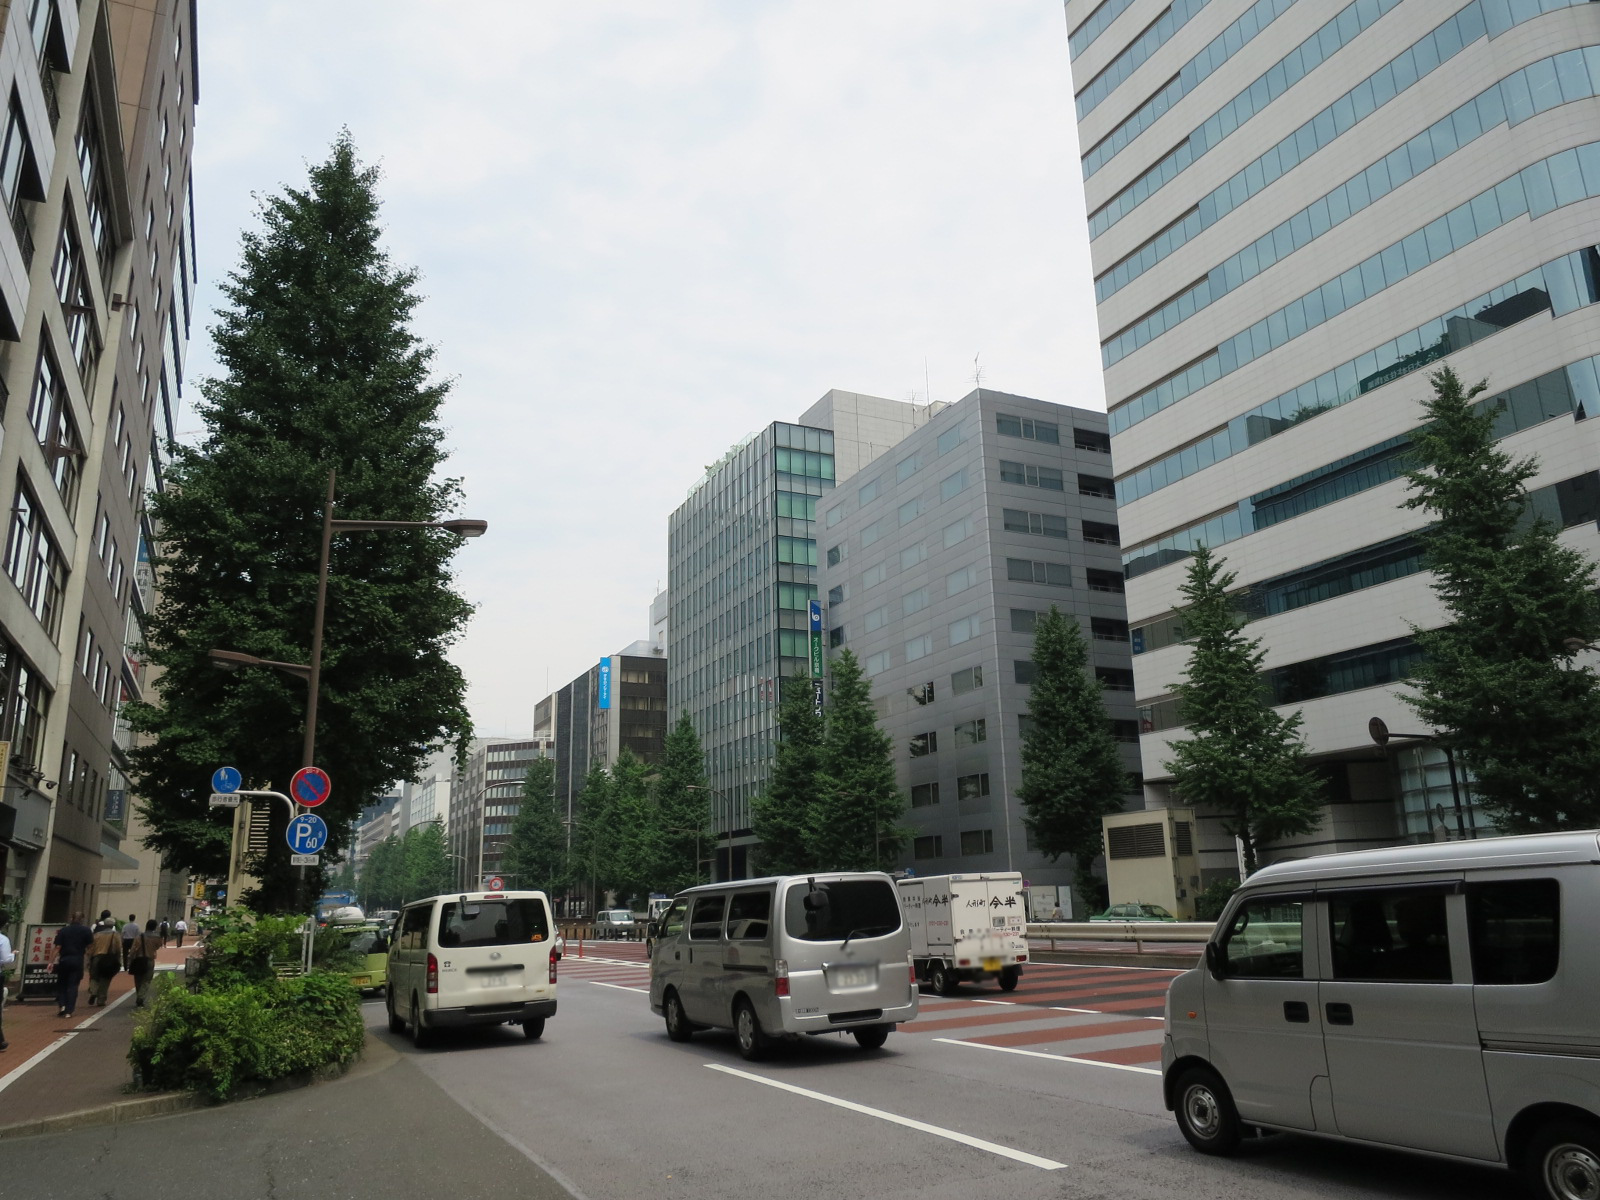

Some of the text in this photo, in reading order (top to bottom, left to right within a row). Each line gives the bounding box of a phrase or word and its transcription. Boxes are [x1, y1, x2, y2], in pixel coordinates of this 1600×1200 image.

[299, 816, 318, 824] 9-20
[295, 823, 312, 849] P
[305, 837, 318, 849] 60
